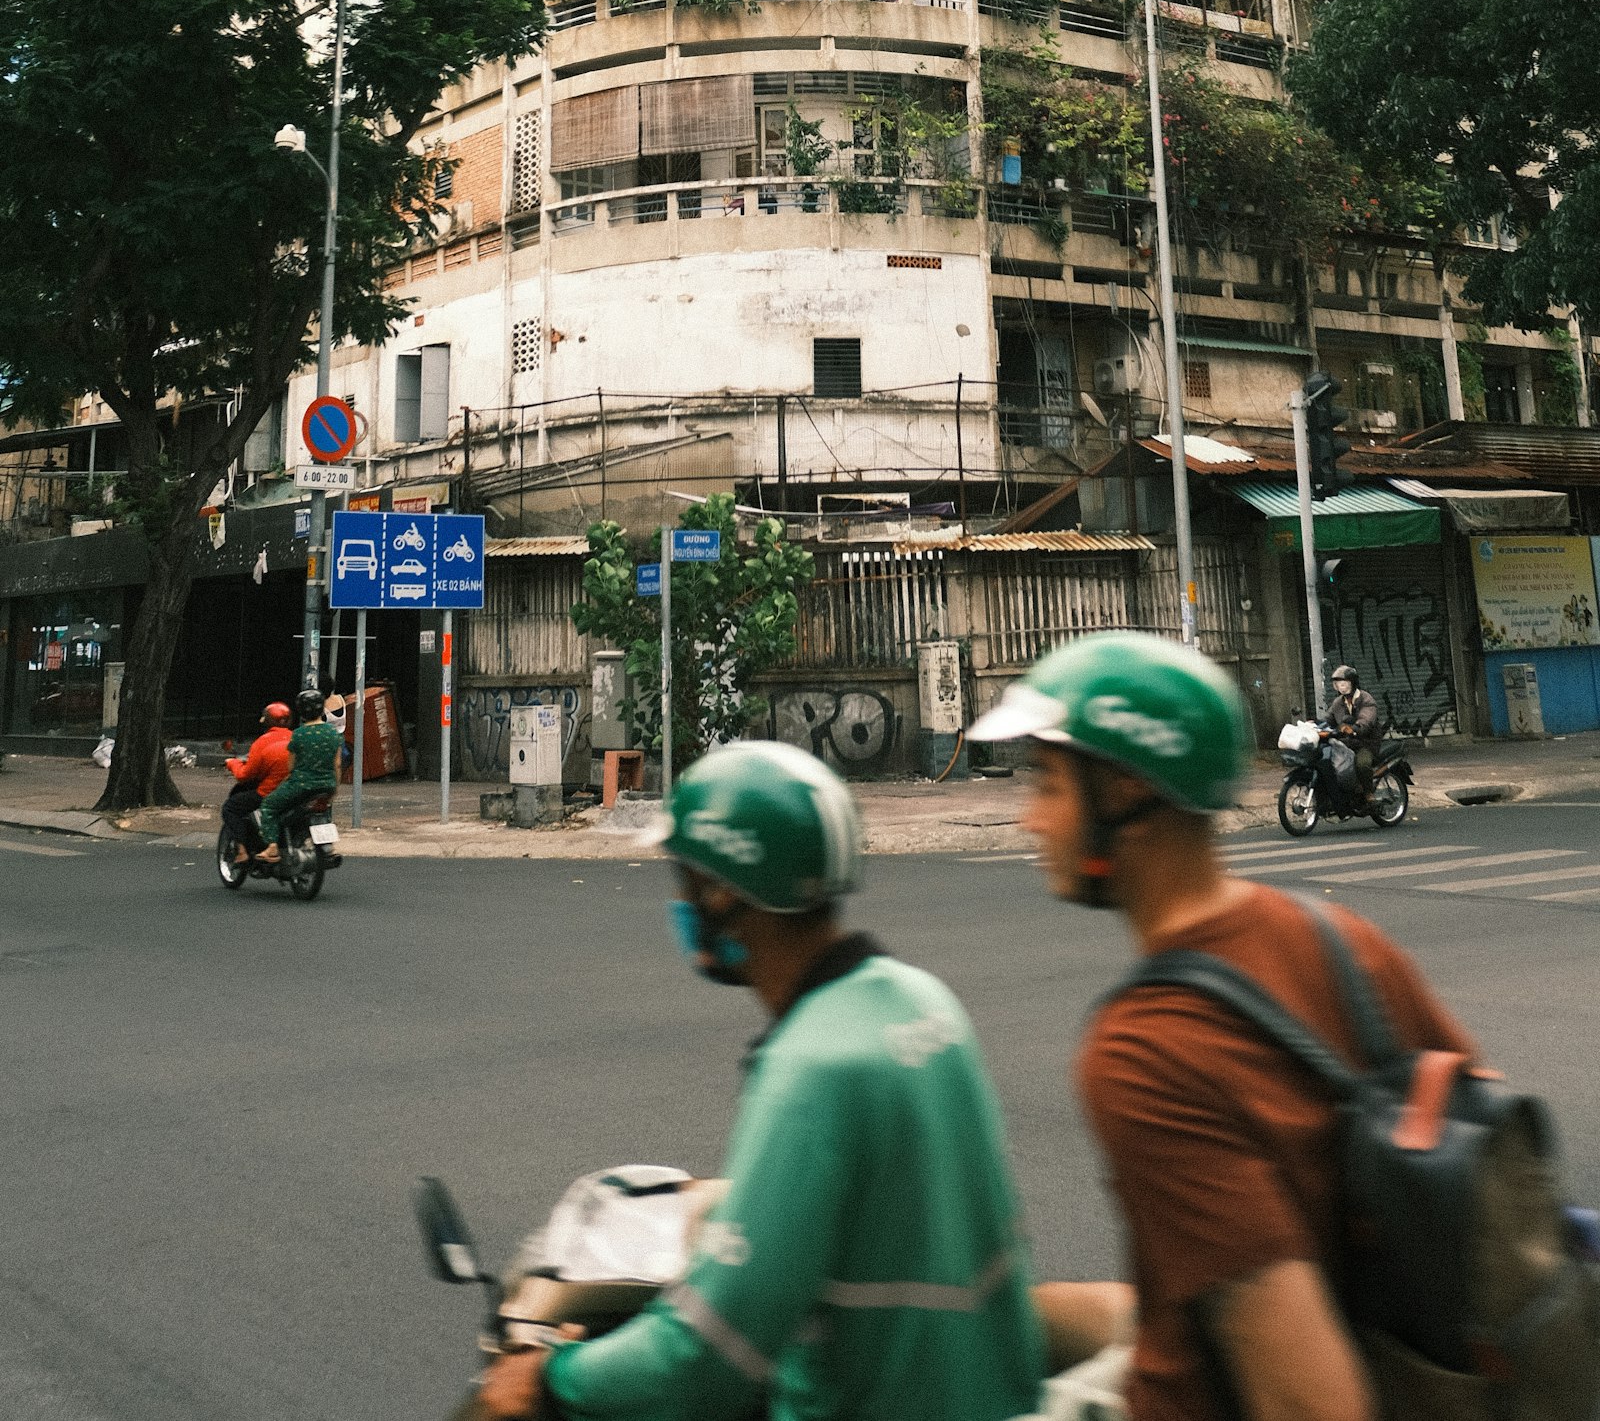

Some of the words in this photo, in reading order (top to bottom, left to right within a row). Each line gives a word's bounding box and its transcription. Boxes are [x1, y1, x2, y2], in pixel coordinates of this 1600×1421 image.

[436, 579, 448, 591] XE
[449, 579, 459, 591] 02
[459, 576, 482, 591] BÁNH
